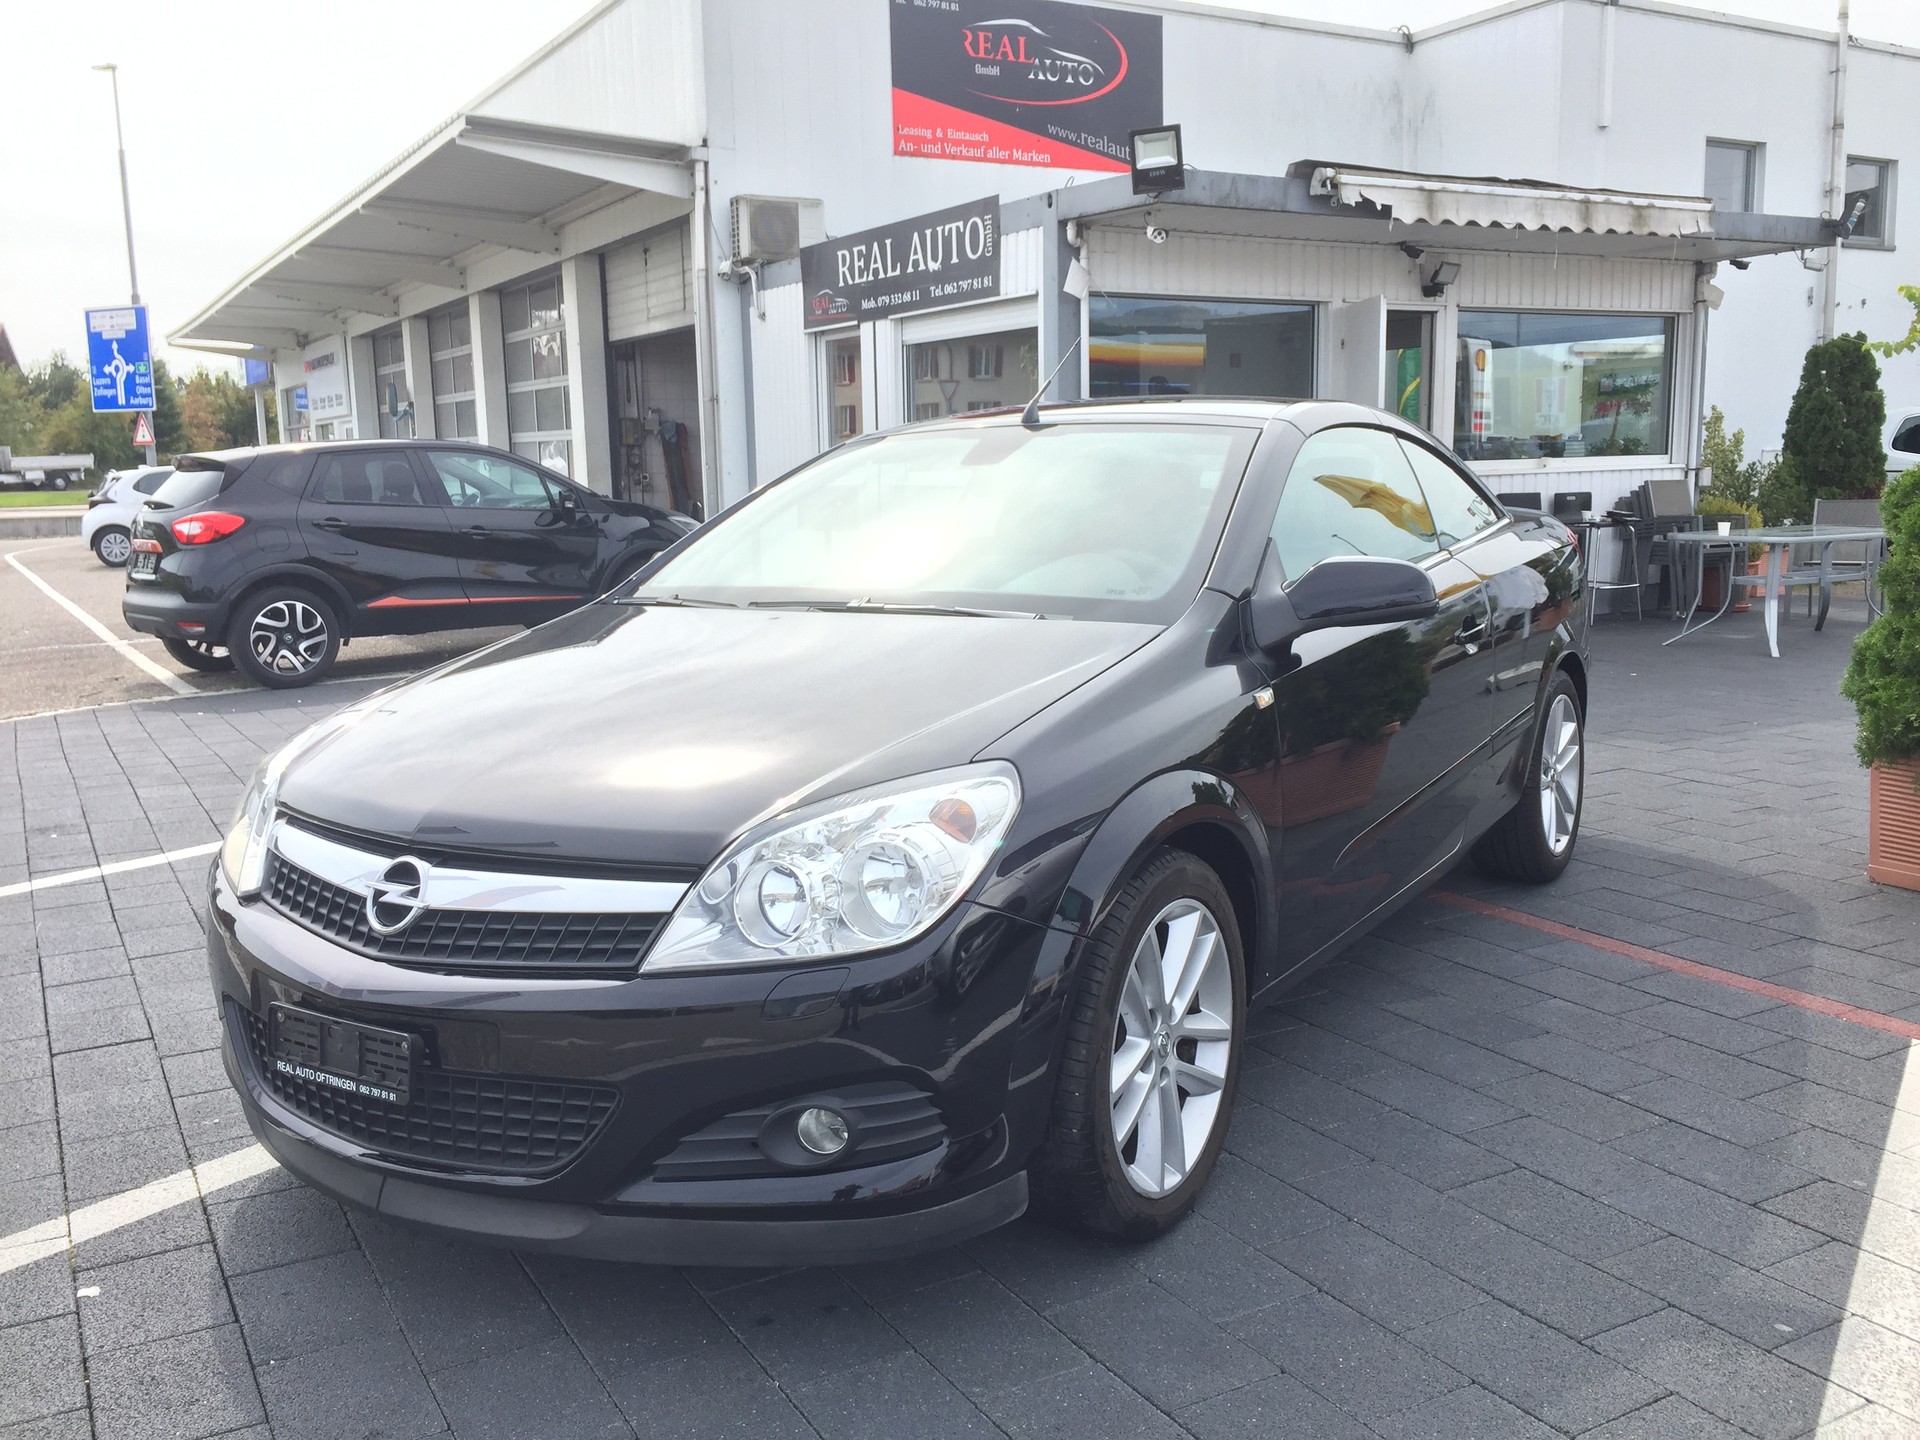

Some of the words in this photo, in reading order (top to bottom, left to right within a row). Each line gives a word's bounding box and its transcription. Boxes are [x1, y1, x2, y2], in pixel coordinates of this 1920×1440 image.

[928, 0, 940, 8] 797
[941, 1, 950, 10] 81
[950, 2, 960, 11] 81
[963, 29, 1034, 64] REAL
[975, 63, 1000, 76] GmbH
[1028, 57, 1095, 86] AUTO
[898, 124, 932, 139] Leasing
[936, 128, 944, 138] &
[947, 128, 989, 142] Eintausch
[1047, 124, 1131, 161] www.realaut
[899, 139, 918, 152] An-
[921, 142, 941, 154] und
[944, 143, 985, 158] Verkauf
[987, 146, 1010, 160] aller
[1012, 149, 1051, 163] Marken
[984, 214, 992, 257] GmbH
[837, 239, 900, 287] REAL
[906, 216, 985, 273] AUTO
[930, 285, 943, 297] Tel.
[944, 281, 957, 295] 062
[958, 279, 972, 292] 797
[972, 277, 982, 289] 81
[983, 275, 993, 287] 81
[861, 297, 877, 310] Mob.
[877, 293, 889, 307] 079
[890, 291, 902, 305] 332
[902, 290, 911, 303] 68
[912, 289, 920, 302] 11
[93, 377, 111, 385] Luzern
[136, 375, 150, 384] Basel
[136, 385, 151, 395] Olten
[94, 387, 116, 398] Zofingen
[130, 396, 152, 406] Aarburg
[277, 1060, 294, 1075] REAL
[295, 1066, 315, 1080] AUTO
[316, 1072, 356, 1091] OFTRINGEN
[359, 1084, 370, 1095] 062
[371, 1087, 381, 1098] 797
[381, 1090, 389, 1099] 81
[389, 1092, 397, 1101] 81
